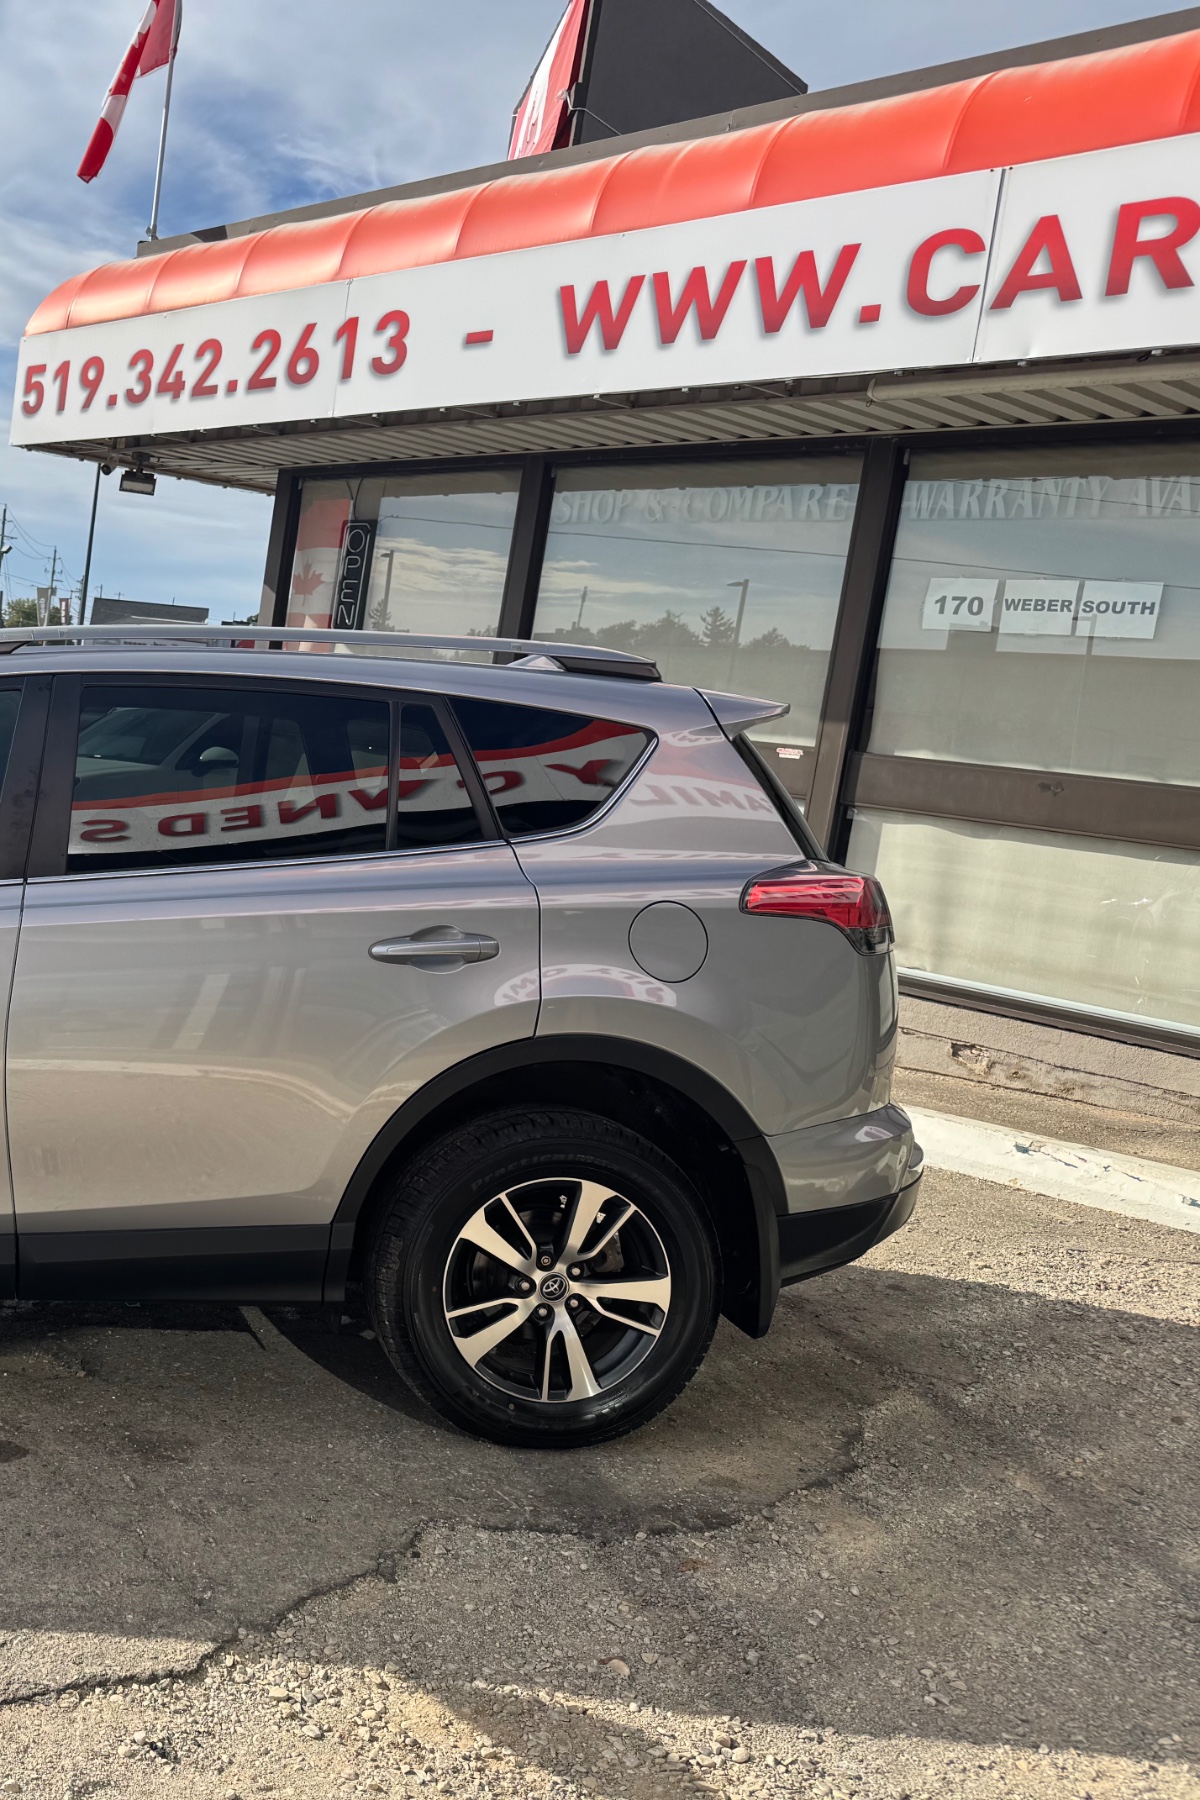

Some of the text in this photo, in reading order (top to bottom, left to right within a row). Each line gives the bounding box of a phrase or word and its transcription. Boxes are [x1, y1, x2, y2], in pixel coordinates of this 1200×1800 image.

[21, 309, 411, 416] 519.342.2613
[559, 195, 1200, 355] WWW.CAR
[552, 490, 629, 525] SHOP
[680, 485, 848, 523] COMPARE
[909, 476, 1113, 520] WARRANTY
[337, 529, 365, 625] OPEN
[934, 595, 1156, 616] 170 WEBER SOUTH
